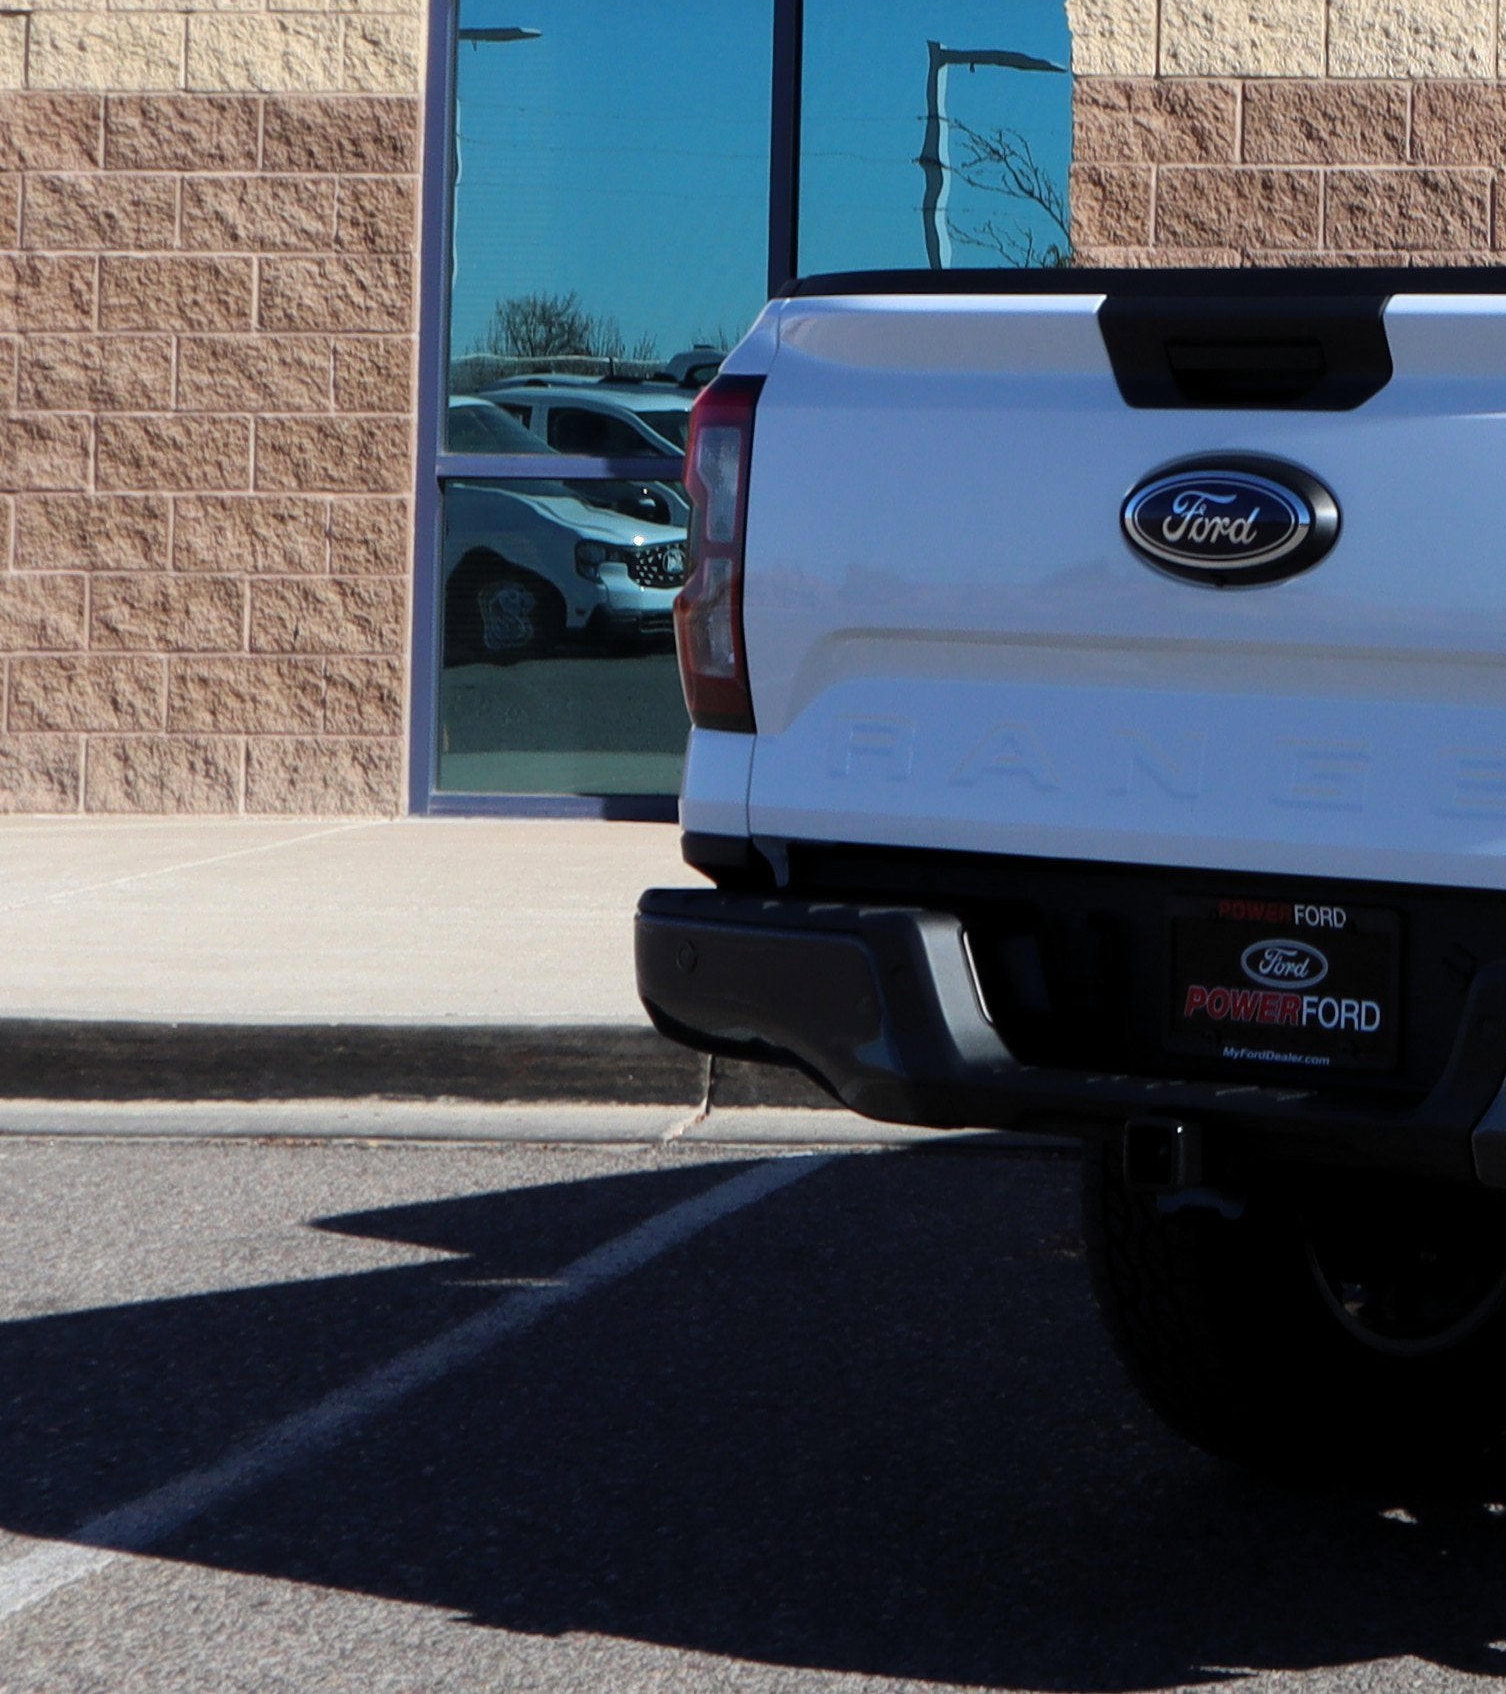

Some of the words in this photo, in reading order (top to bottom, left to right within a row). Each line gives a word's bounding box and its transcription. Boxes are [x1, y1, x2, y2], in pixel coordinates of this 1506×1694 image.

[1162, 490, 1261, 545] Ford
[1258, 947, 1310, 978] Ford
[1222, 1045, 1330, 1066] MyFordDealer.com
